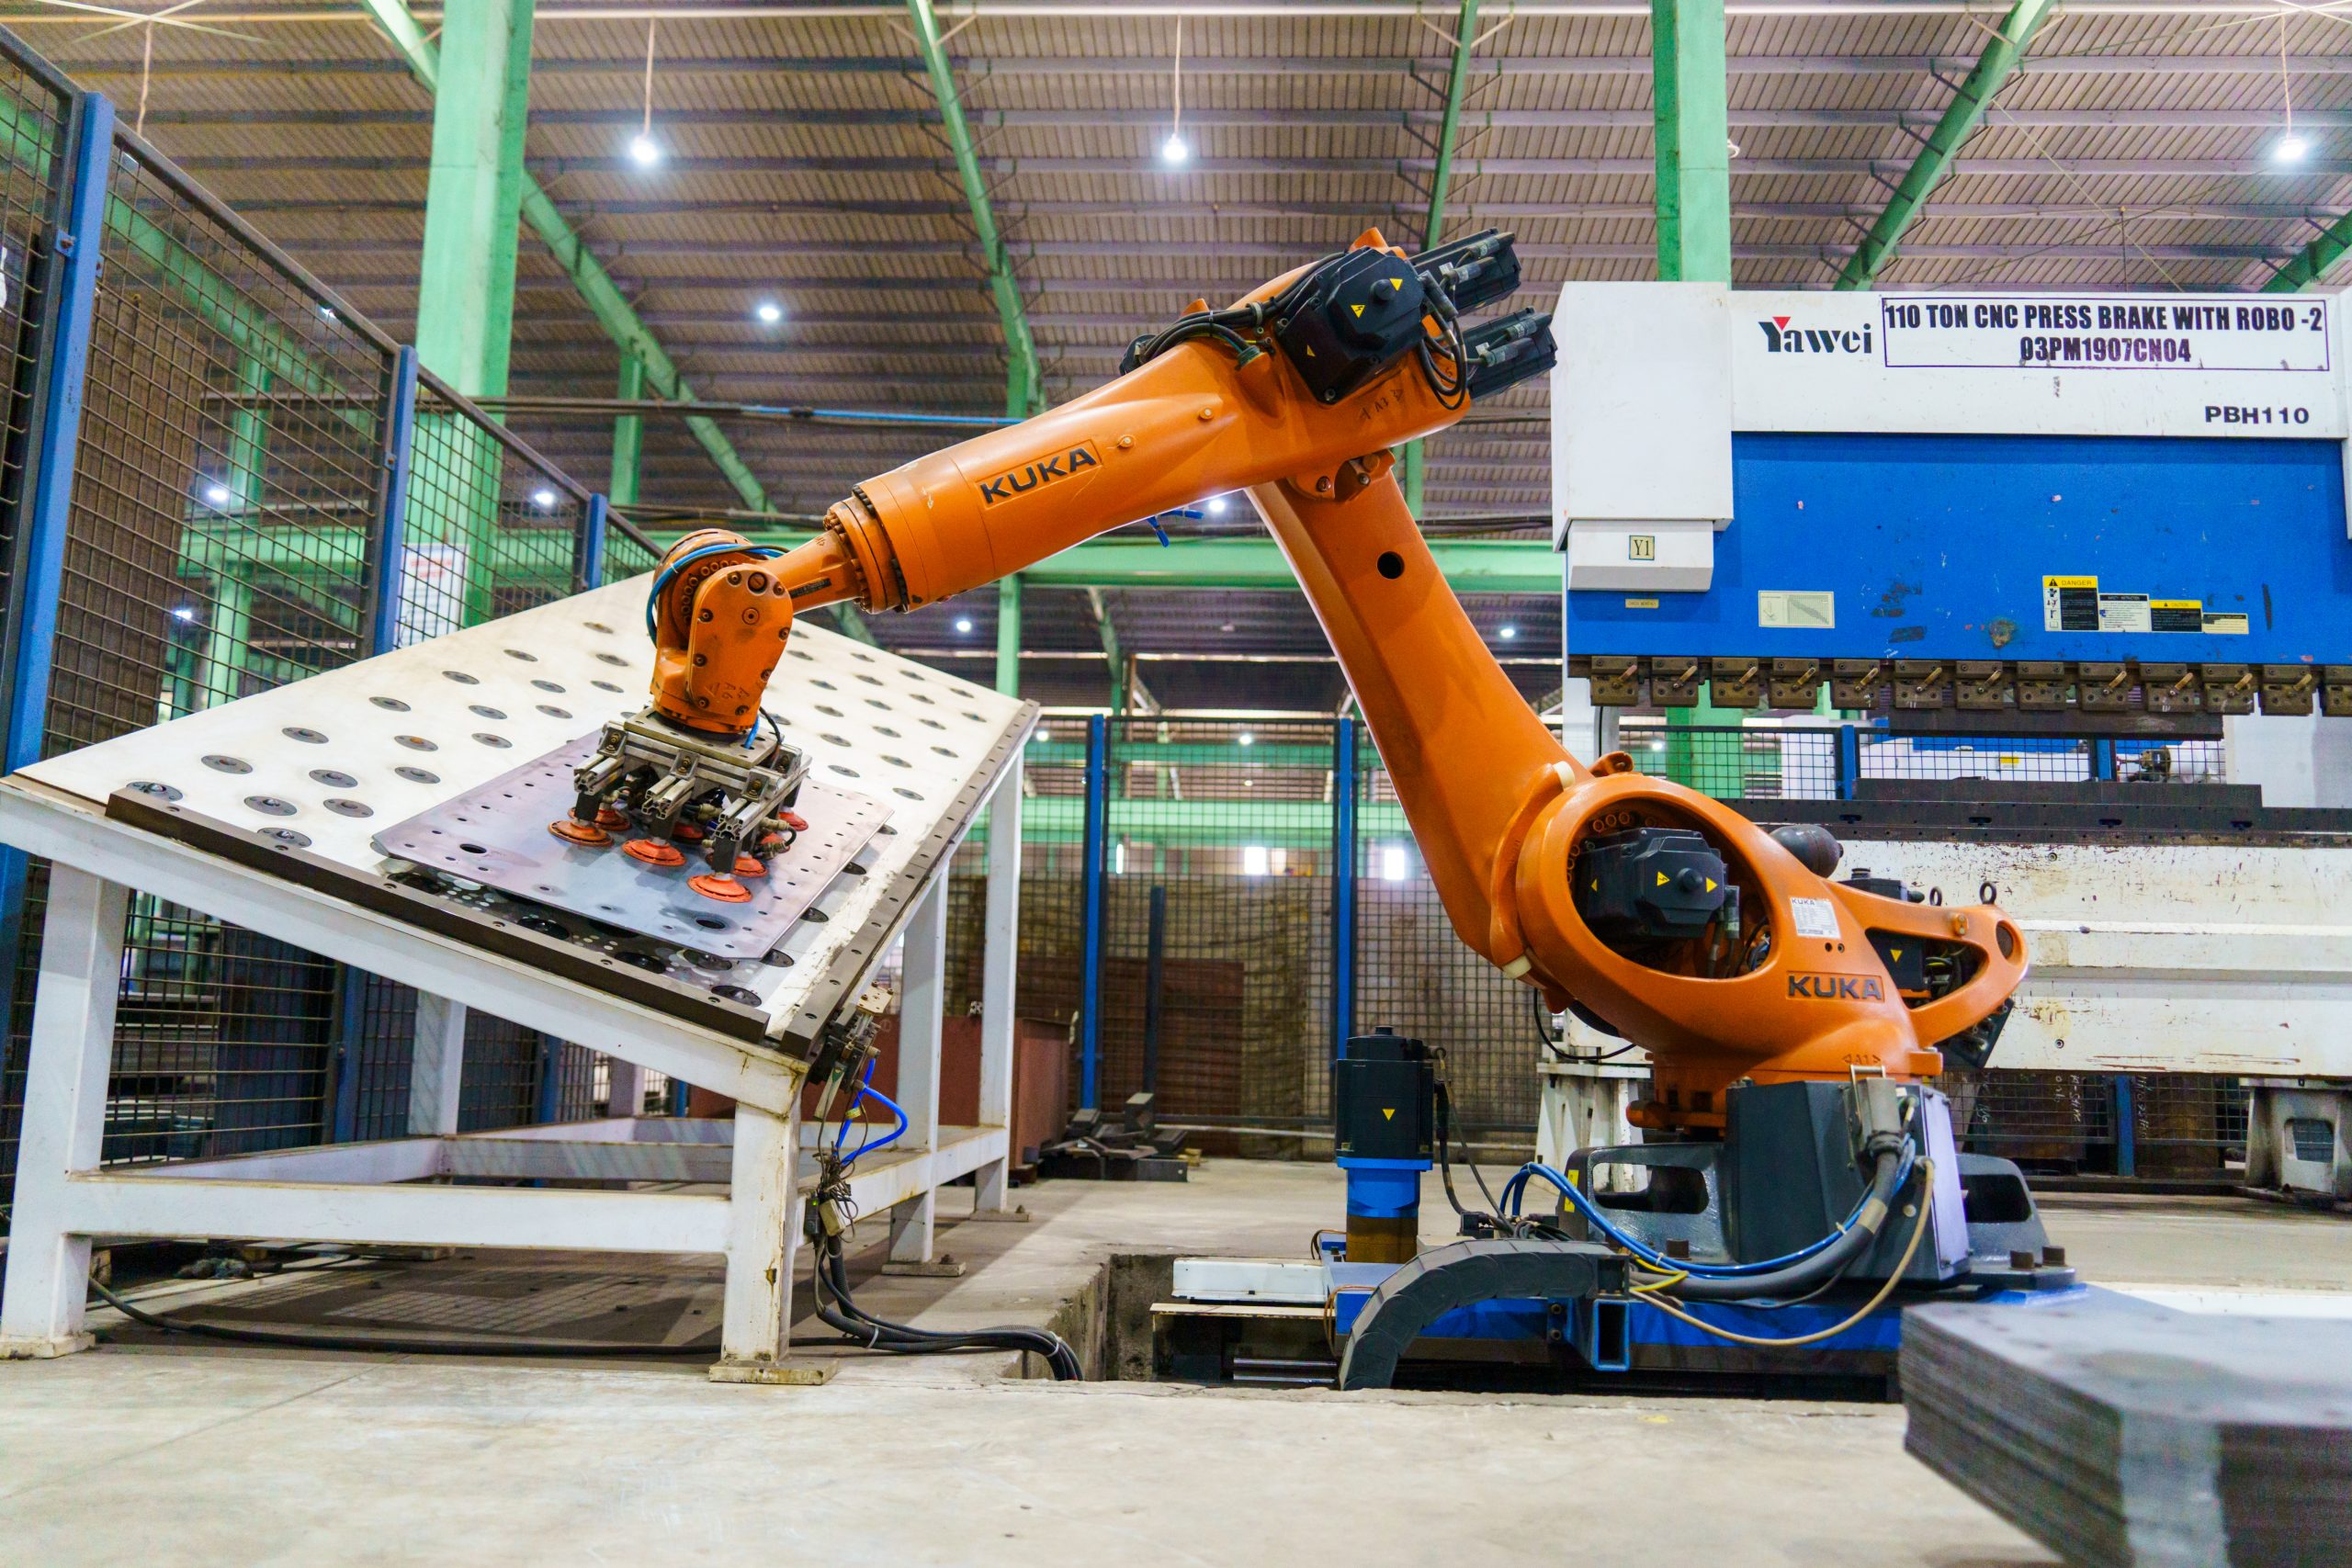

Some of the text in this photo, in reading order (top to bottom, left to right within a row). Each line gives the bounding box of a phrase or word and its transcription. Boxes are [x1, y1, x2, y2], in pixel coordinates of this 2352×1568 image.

[1885, 305, 1921, 329] 110
[1926, 305, 1968, 329] TON
[1974, 305, 2018, 329] CNC
[2025, 305, 2092, 329] PRESS
[2098, 306, 2167, 330] BRAKE
[2173, 307, 2230, 331] WITH
[2237, 307, 2295, 331] ROBO
[1758, 316, 1872, 354] Yawei
[2020, 336, 2191, 362] 03PM1907CN04
[2204, 405, 2310, 424] PBH110
[980, 447, 1097, 504] KUKA
[1634, 539, 1650, 556] Y1
[2061, 579, 2092, 587] DANGER
[1792, 897, 1815, 906] KUKA
[1788, 975, 1882, 999] KUKA
